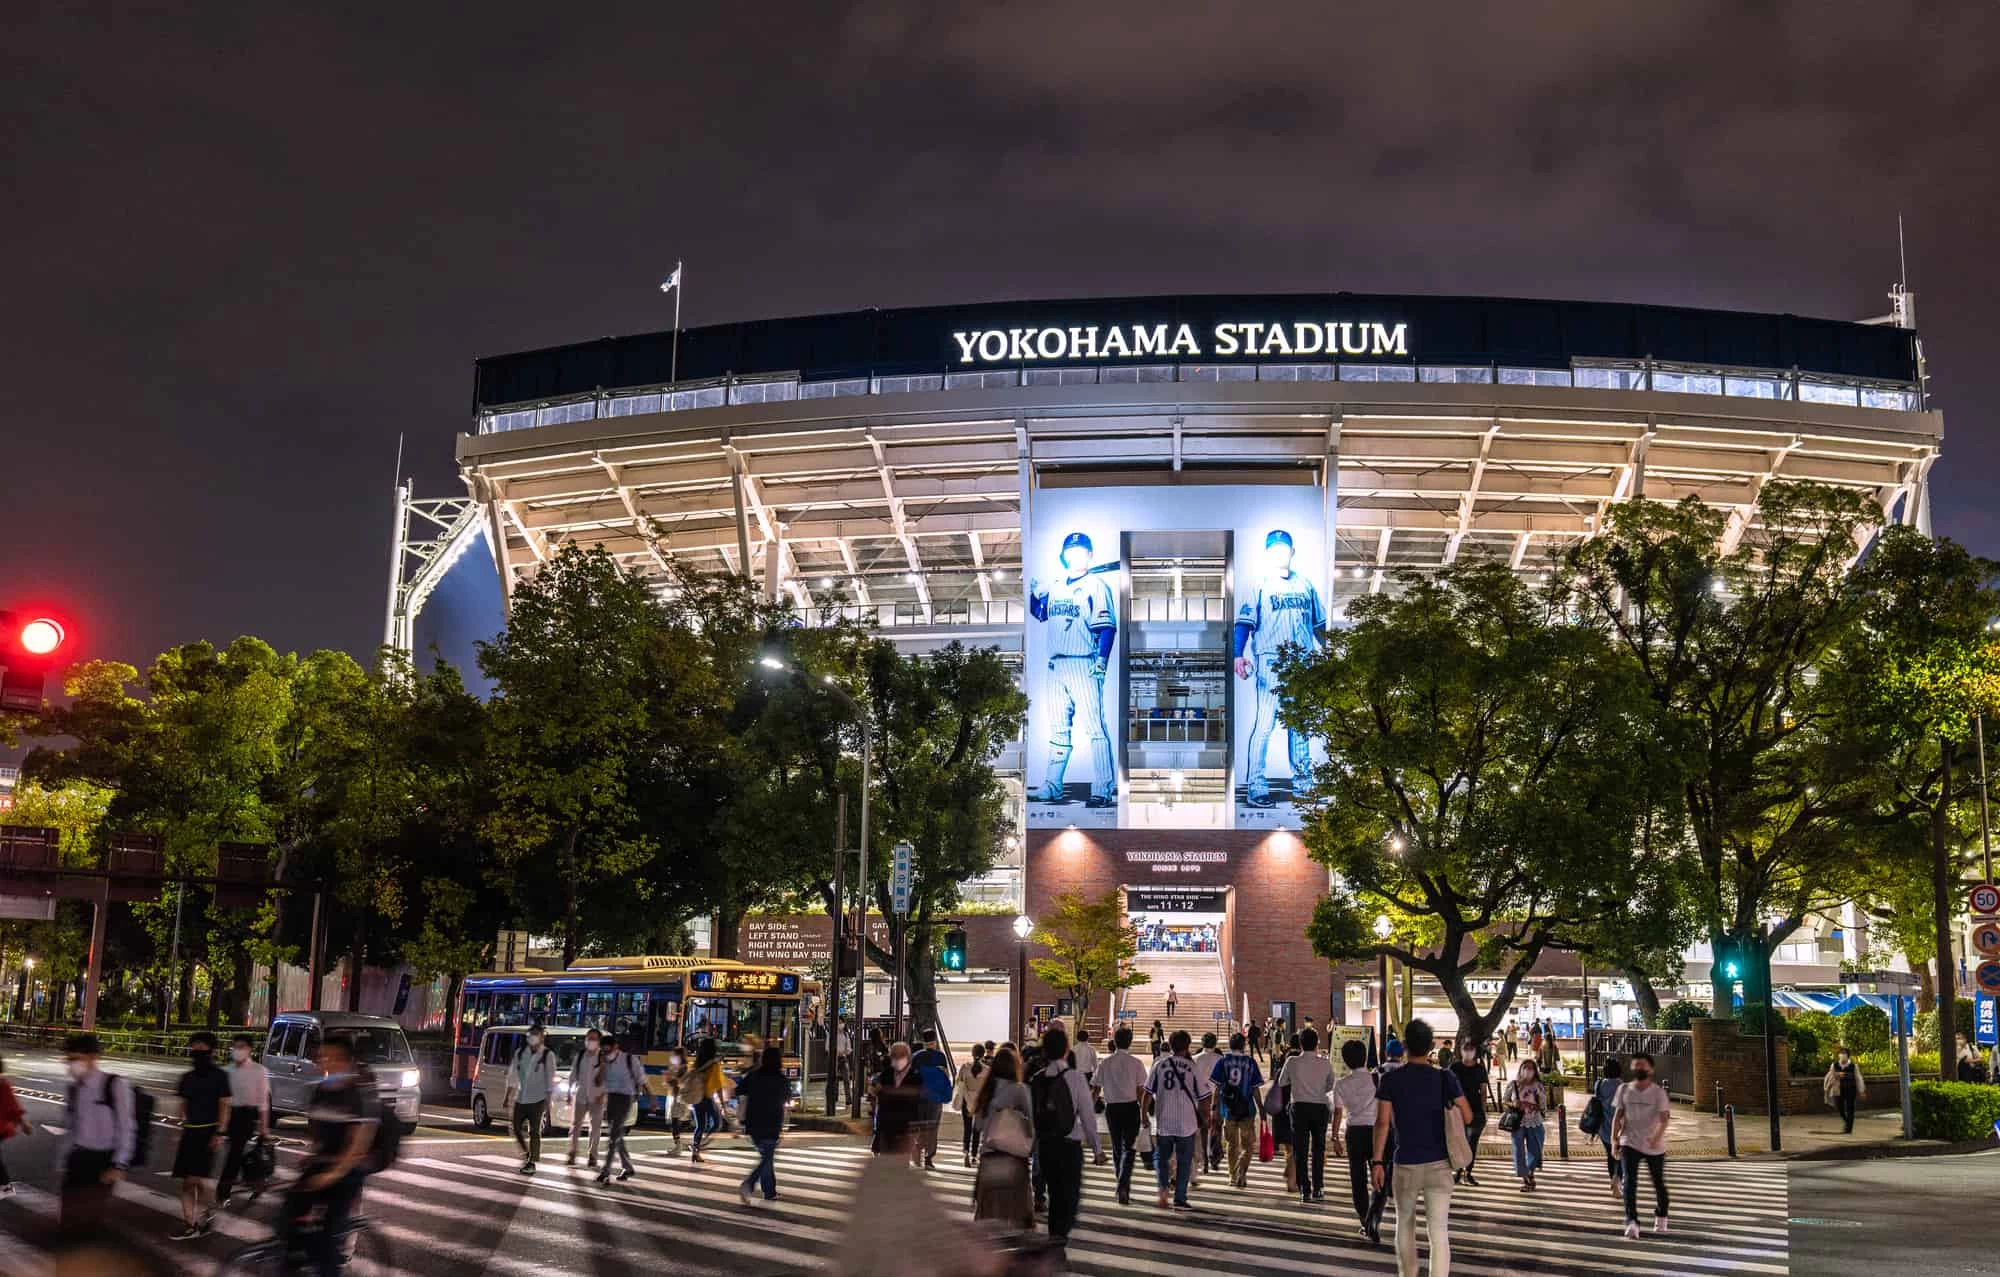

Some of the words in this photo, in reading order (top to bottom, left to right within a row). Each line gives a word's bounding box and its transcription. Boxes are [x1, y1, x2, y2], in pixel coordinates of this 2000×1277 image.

[954, 324, 1200, 362] YOKOHAMA
[1215, 323, 1408, 355] STADIUM
[1064, 618, 1073, 632] 7
[1126, 851, 1182, 862] YOKOHAMA
[1183, 851, 1228, 863] STADIUM
[1976, 892, 1996, 907] 50
[748, 932, 769, 940] LEFT
[770, 932, 799, 940] STAND
[748, 941, 774, 949] RIGHT
[776, 941, 805, 949] STAND
[766, 951, 790, 959] WING
[792, 951, 809, 959] BAY
[1230, 1067, 1242, 1087] 9
